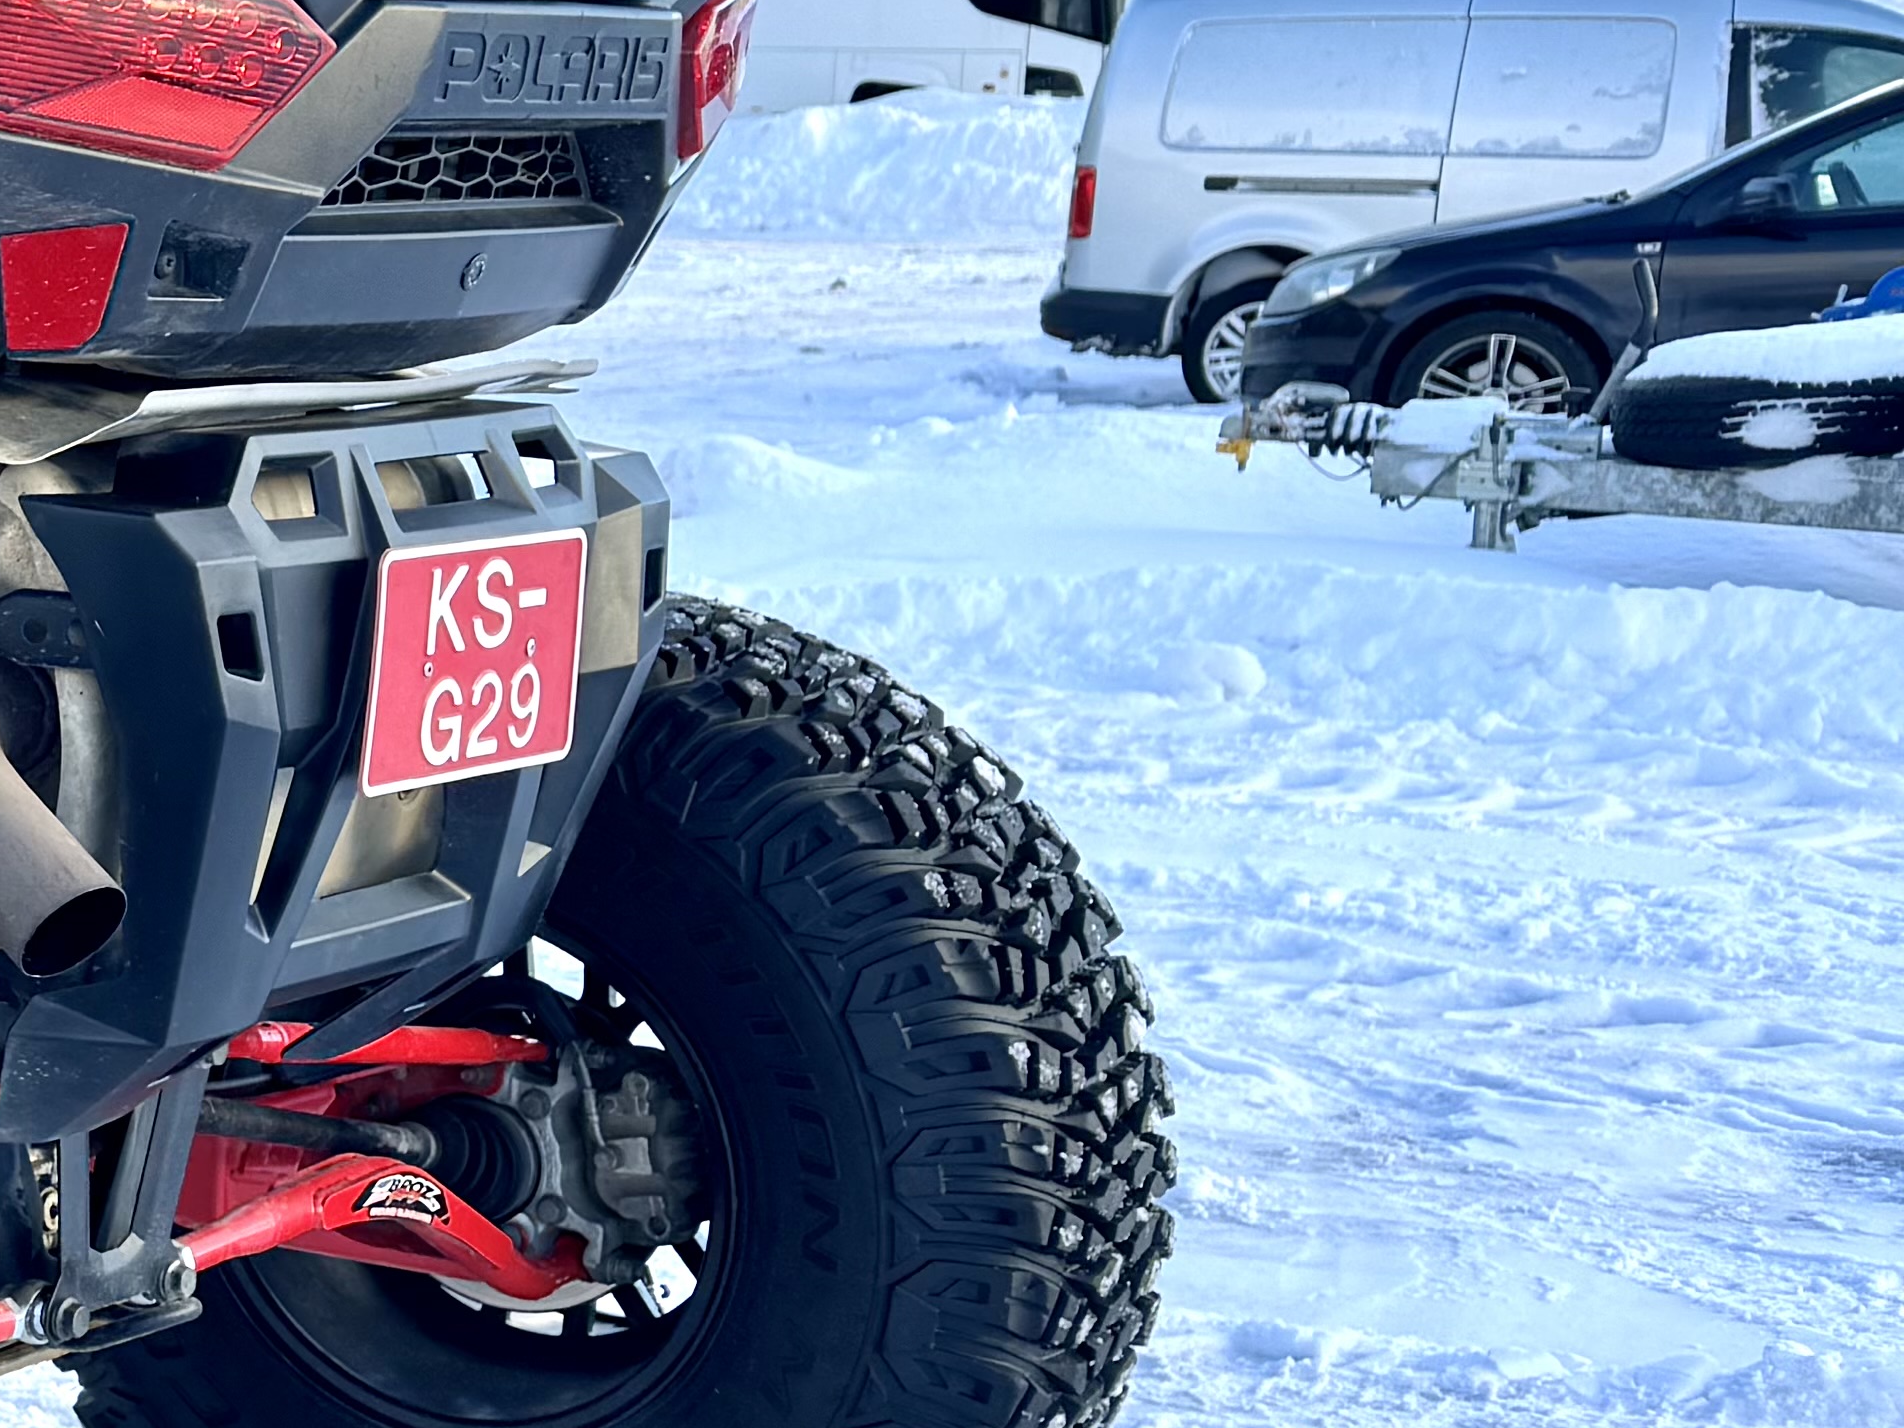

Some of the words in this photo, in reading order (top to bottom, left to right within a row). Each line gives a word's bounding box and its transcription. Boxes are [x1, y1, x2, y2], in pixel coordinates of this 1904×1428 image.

[434, 31, 668, 104] POLARIS
[426, 556, 547, 656] KS-
[420, 662, 541, 766] G29
